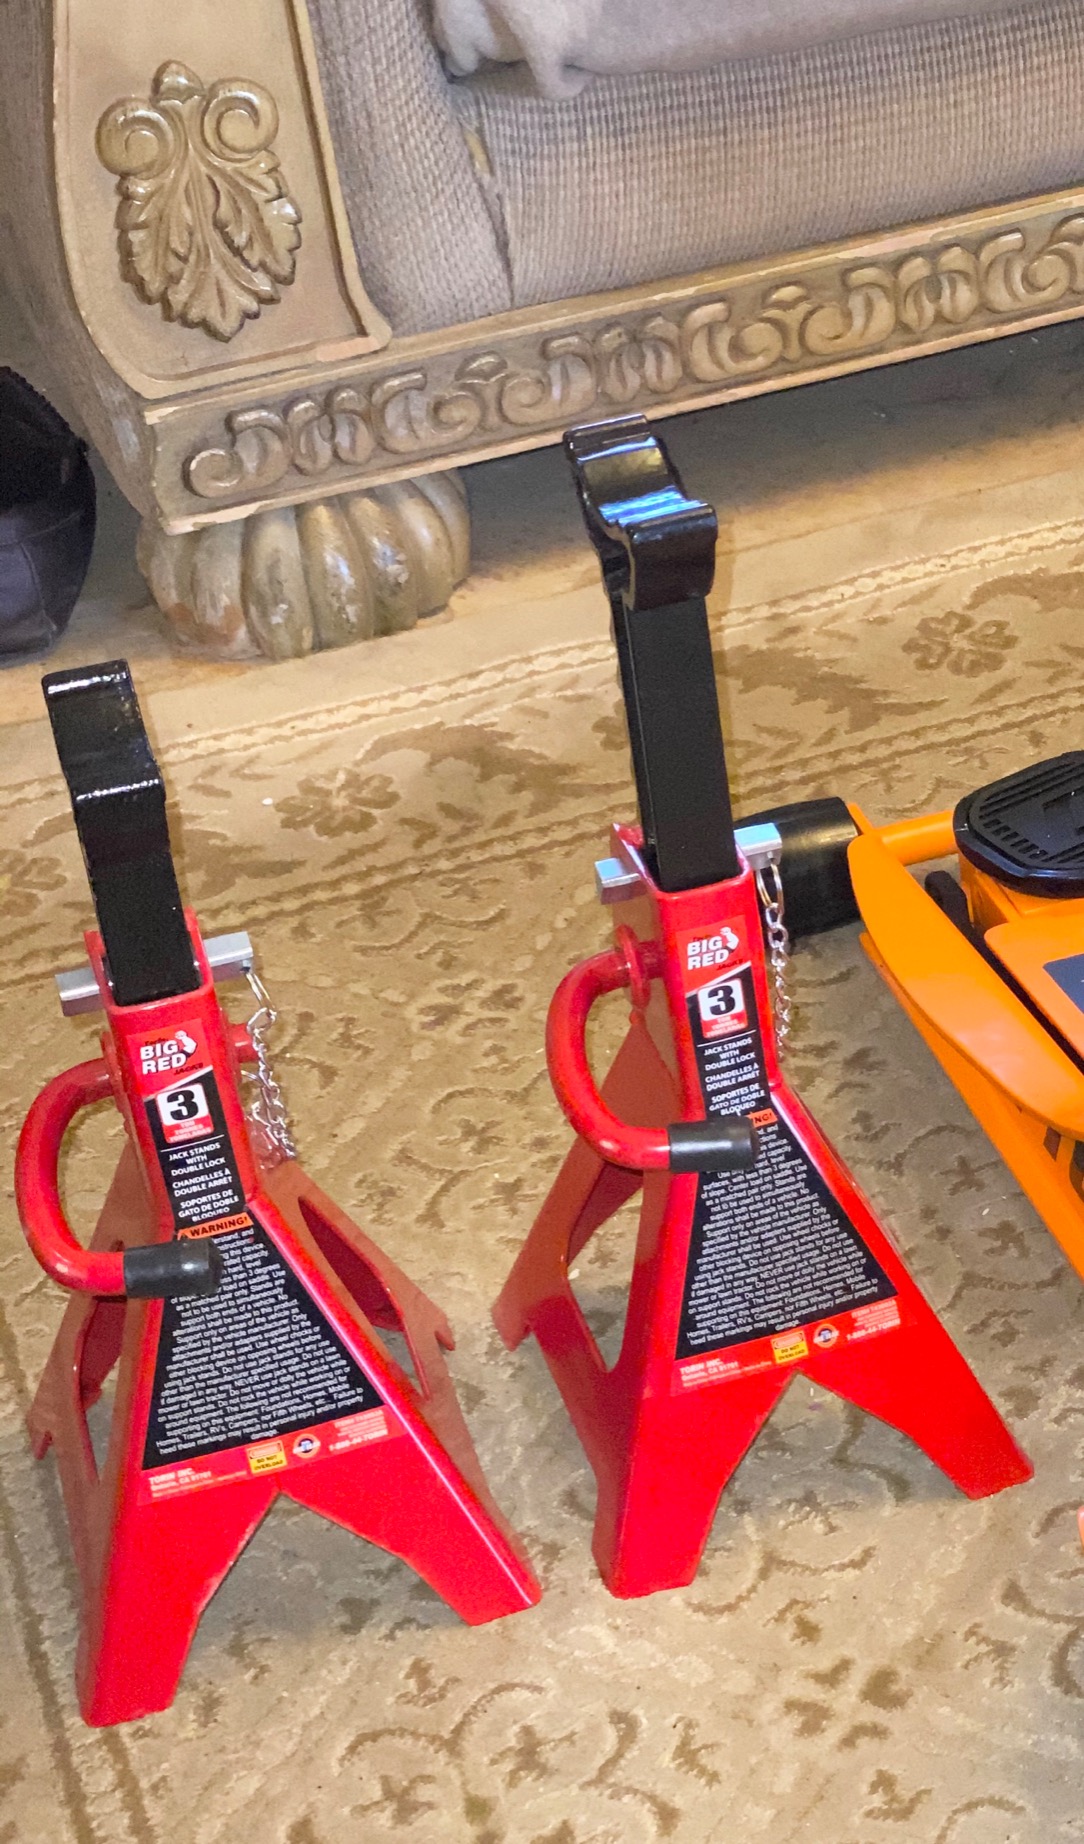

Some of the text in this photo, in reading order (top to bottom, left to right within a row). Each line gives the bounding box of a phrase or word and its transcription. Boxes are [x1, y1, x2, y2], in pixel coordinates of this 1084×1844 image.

[687, 936, 722, 956] BIG
[688, 949, 729, 970] RED
[708, 986, 735, 1015] 3
[140, 1040, 178, 1060] BIG
[704, 1037, 752, 1056] JACK STANDS
[719, 1050, 739, 1059] WITH
[142, 1053, 186, 1074] RED
[705, 1052, 755, 1071] DOUBLE LOCK
[705, 1065, 752, 1083] CHANDELLES
[706, 1078, 736, 1091] DOUBLE
[712, 1083, 760, 1103] SOPORTES DE
[167, 1090, 198, 1120] 3
[709, 1101, 728, 1111] GATO
[741, 1090, 765, 1102] DOBLE
[720, 1101, 755, 1116] BLOQUEO
[169, 1142, 220, 1160] JACK STANDS
[186, 1154, 207, 1164] WITH
[171, 1157, 226, 1176] DOUBLE LOCK
[172, 1170, 223, 1188] CHANDELLES
[174, 1184, 206, 1197] DOUBLE
[178, 1195, 239, 1217] GATO DE DOBLE
[180, 1193, 221, 1208] SOPORTES
[192, 1207, 230, 1222] BLOQUEO
[190, 1216, 247, 1237] WARNING!
